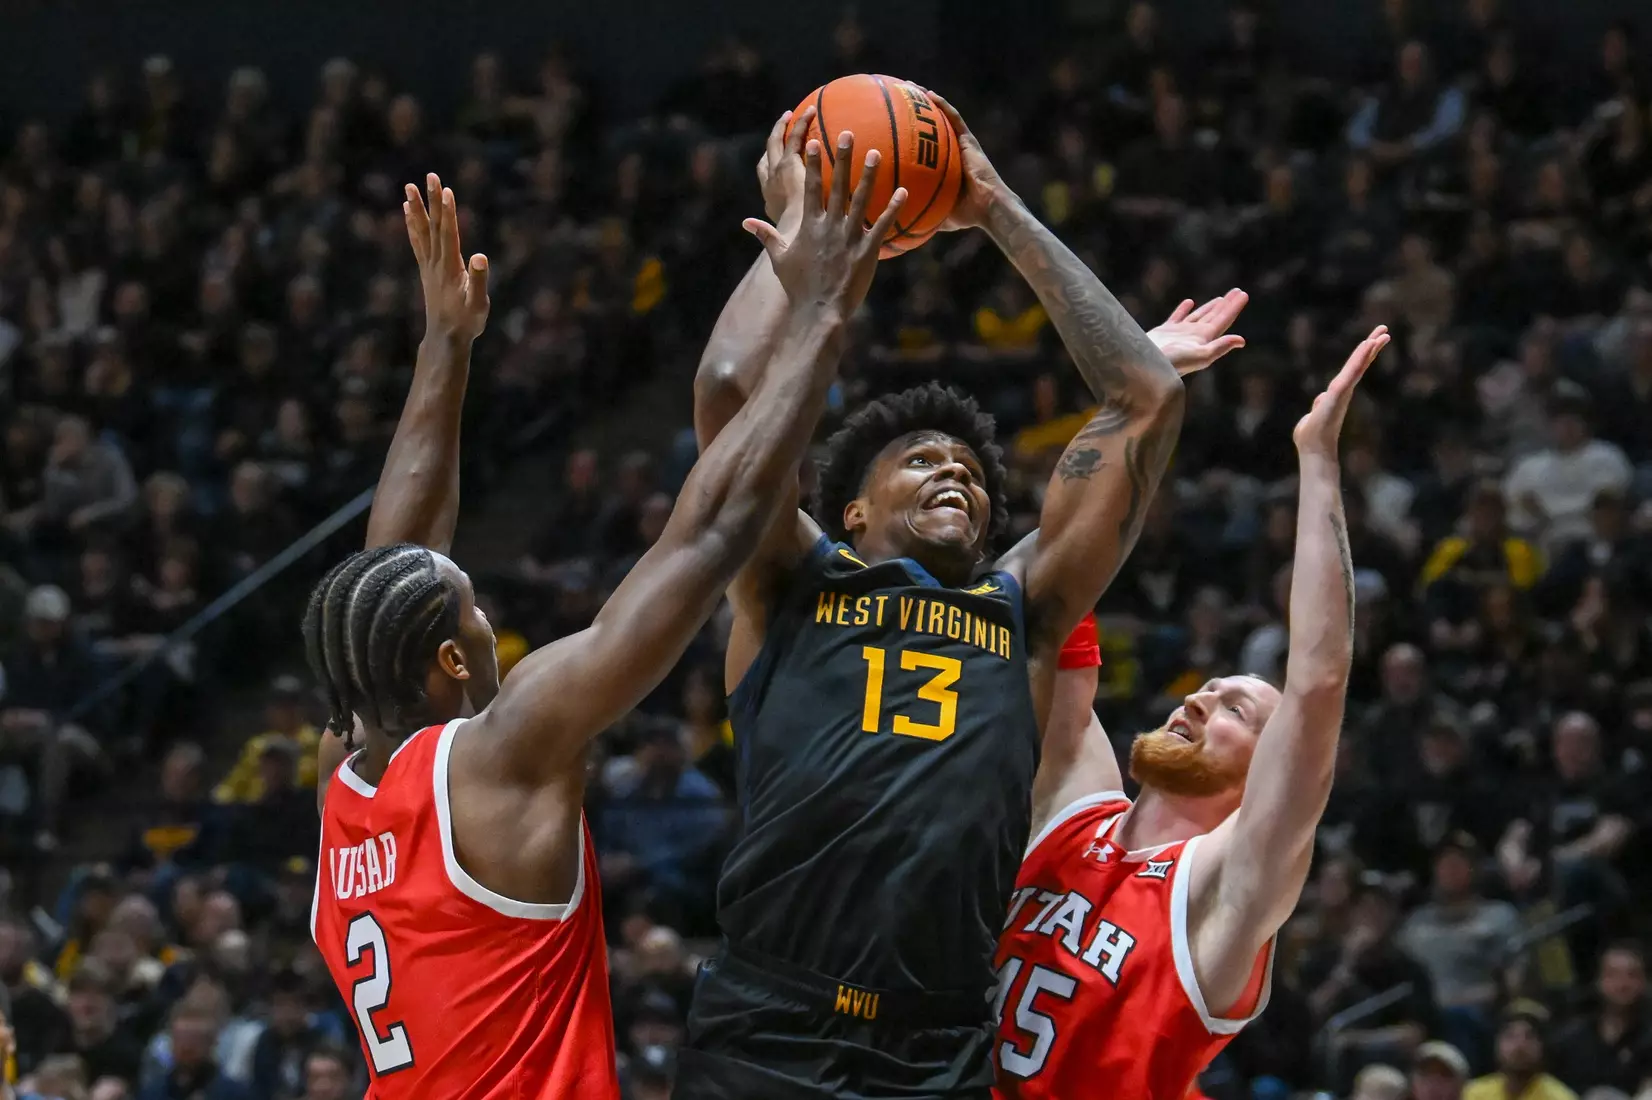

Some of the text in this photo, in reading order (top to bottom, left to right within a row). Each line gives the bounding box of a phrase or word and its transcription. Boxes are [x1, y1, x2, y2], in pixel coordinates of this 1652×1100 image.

[907, 88, 939, 170] ELITE
[815, 592, 1012, 661] WEST VIRGINIA
[861, 645, 962, 742] 13
[345, 910, 415, 1077] 2
[834, 984, 880, 1020] WVU
